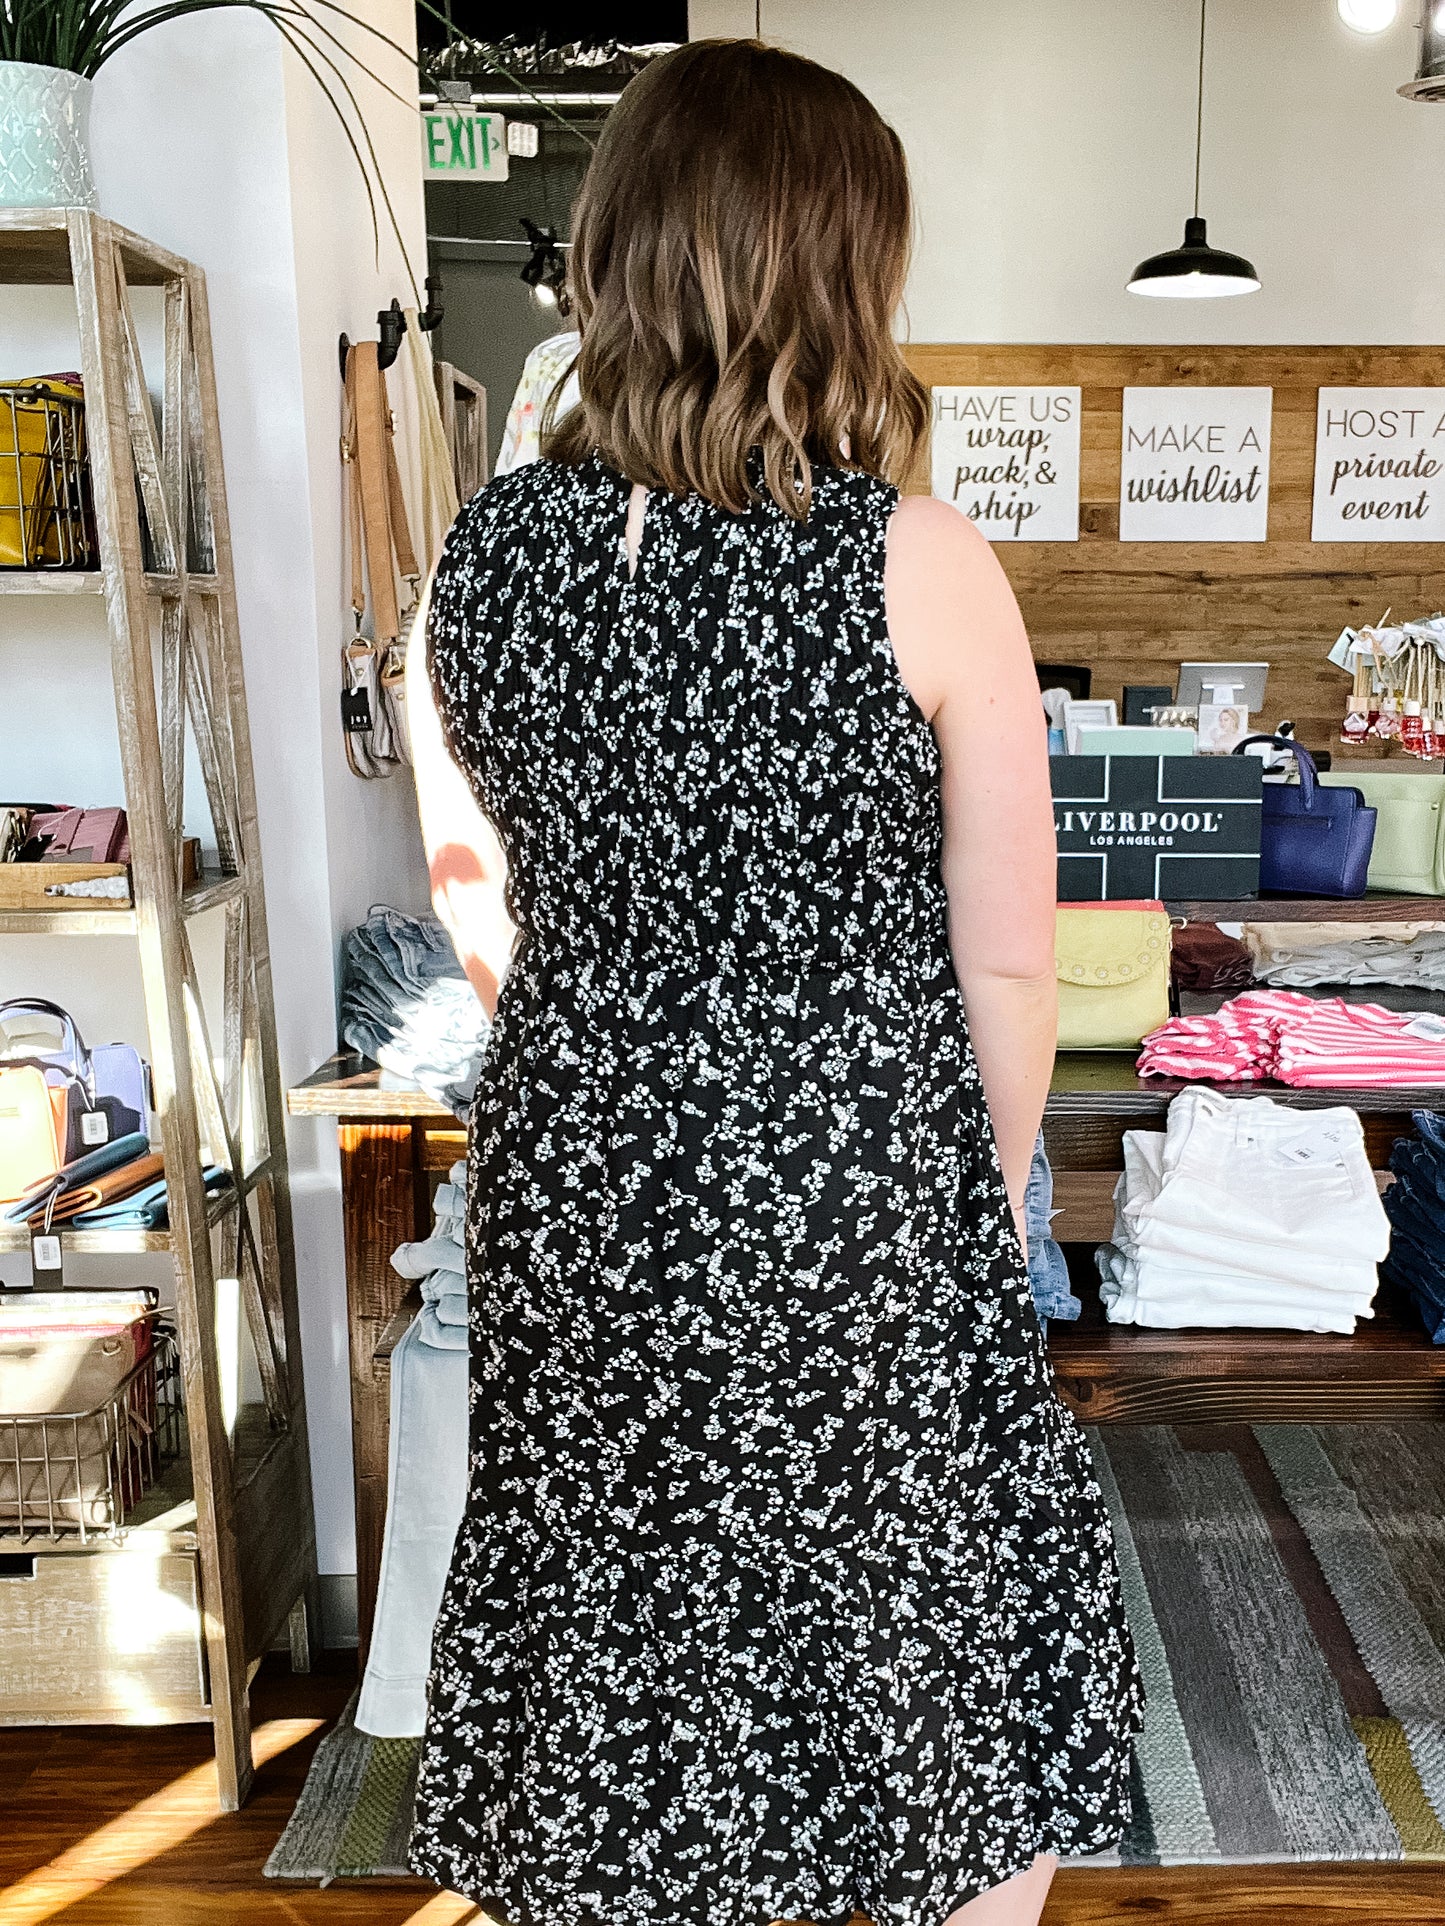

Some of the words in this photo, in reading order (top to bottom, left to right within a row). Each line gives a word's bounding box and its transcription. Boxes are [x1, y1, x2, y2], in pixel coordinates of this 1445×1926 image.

[425, 116, 492, 170] EXIT
[938, 395, 1017, 422] HAVE
[1030, 395, 1072, 423] US
[1326, 409, 1425, 438] HOST
[967, 426, 1051, 466] wrap,
[1127, 425, 1226, 453] MAKE
[1238, 426, 1262, 453] A
[953, 454, 1029, 501] pack,
[1035, 460, 1057, 484] &
[1127, 464, 1261, 503] wishlist
[1330, 448, 1443, 496] private
[966, 490, 1041, 537] ship
[1342, 490, 1430, 520] event
[1089, 835, 1114, 846] LOS
[1117, 835, 1174, 846] ANGELES
